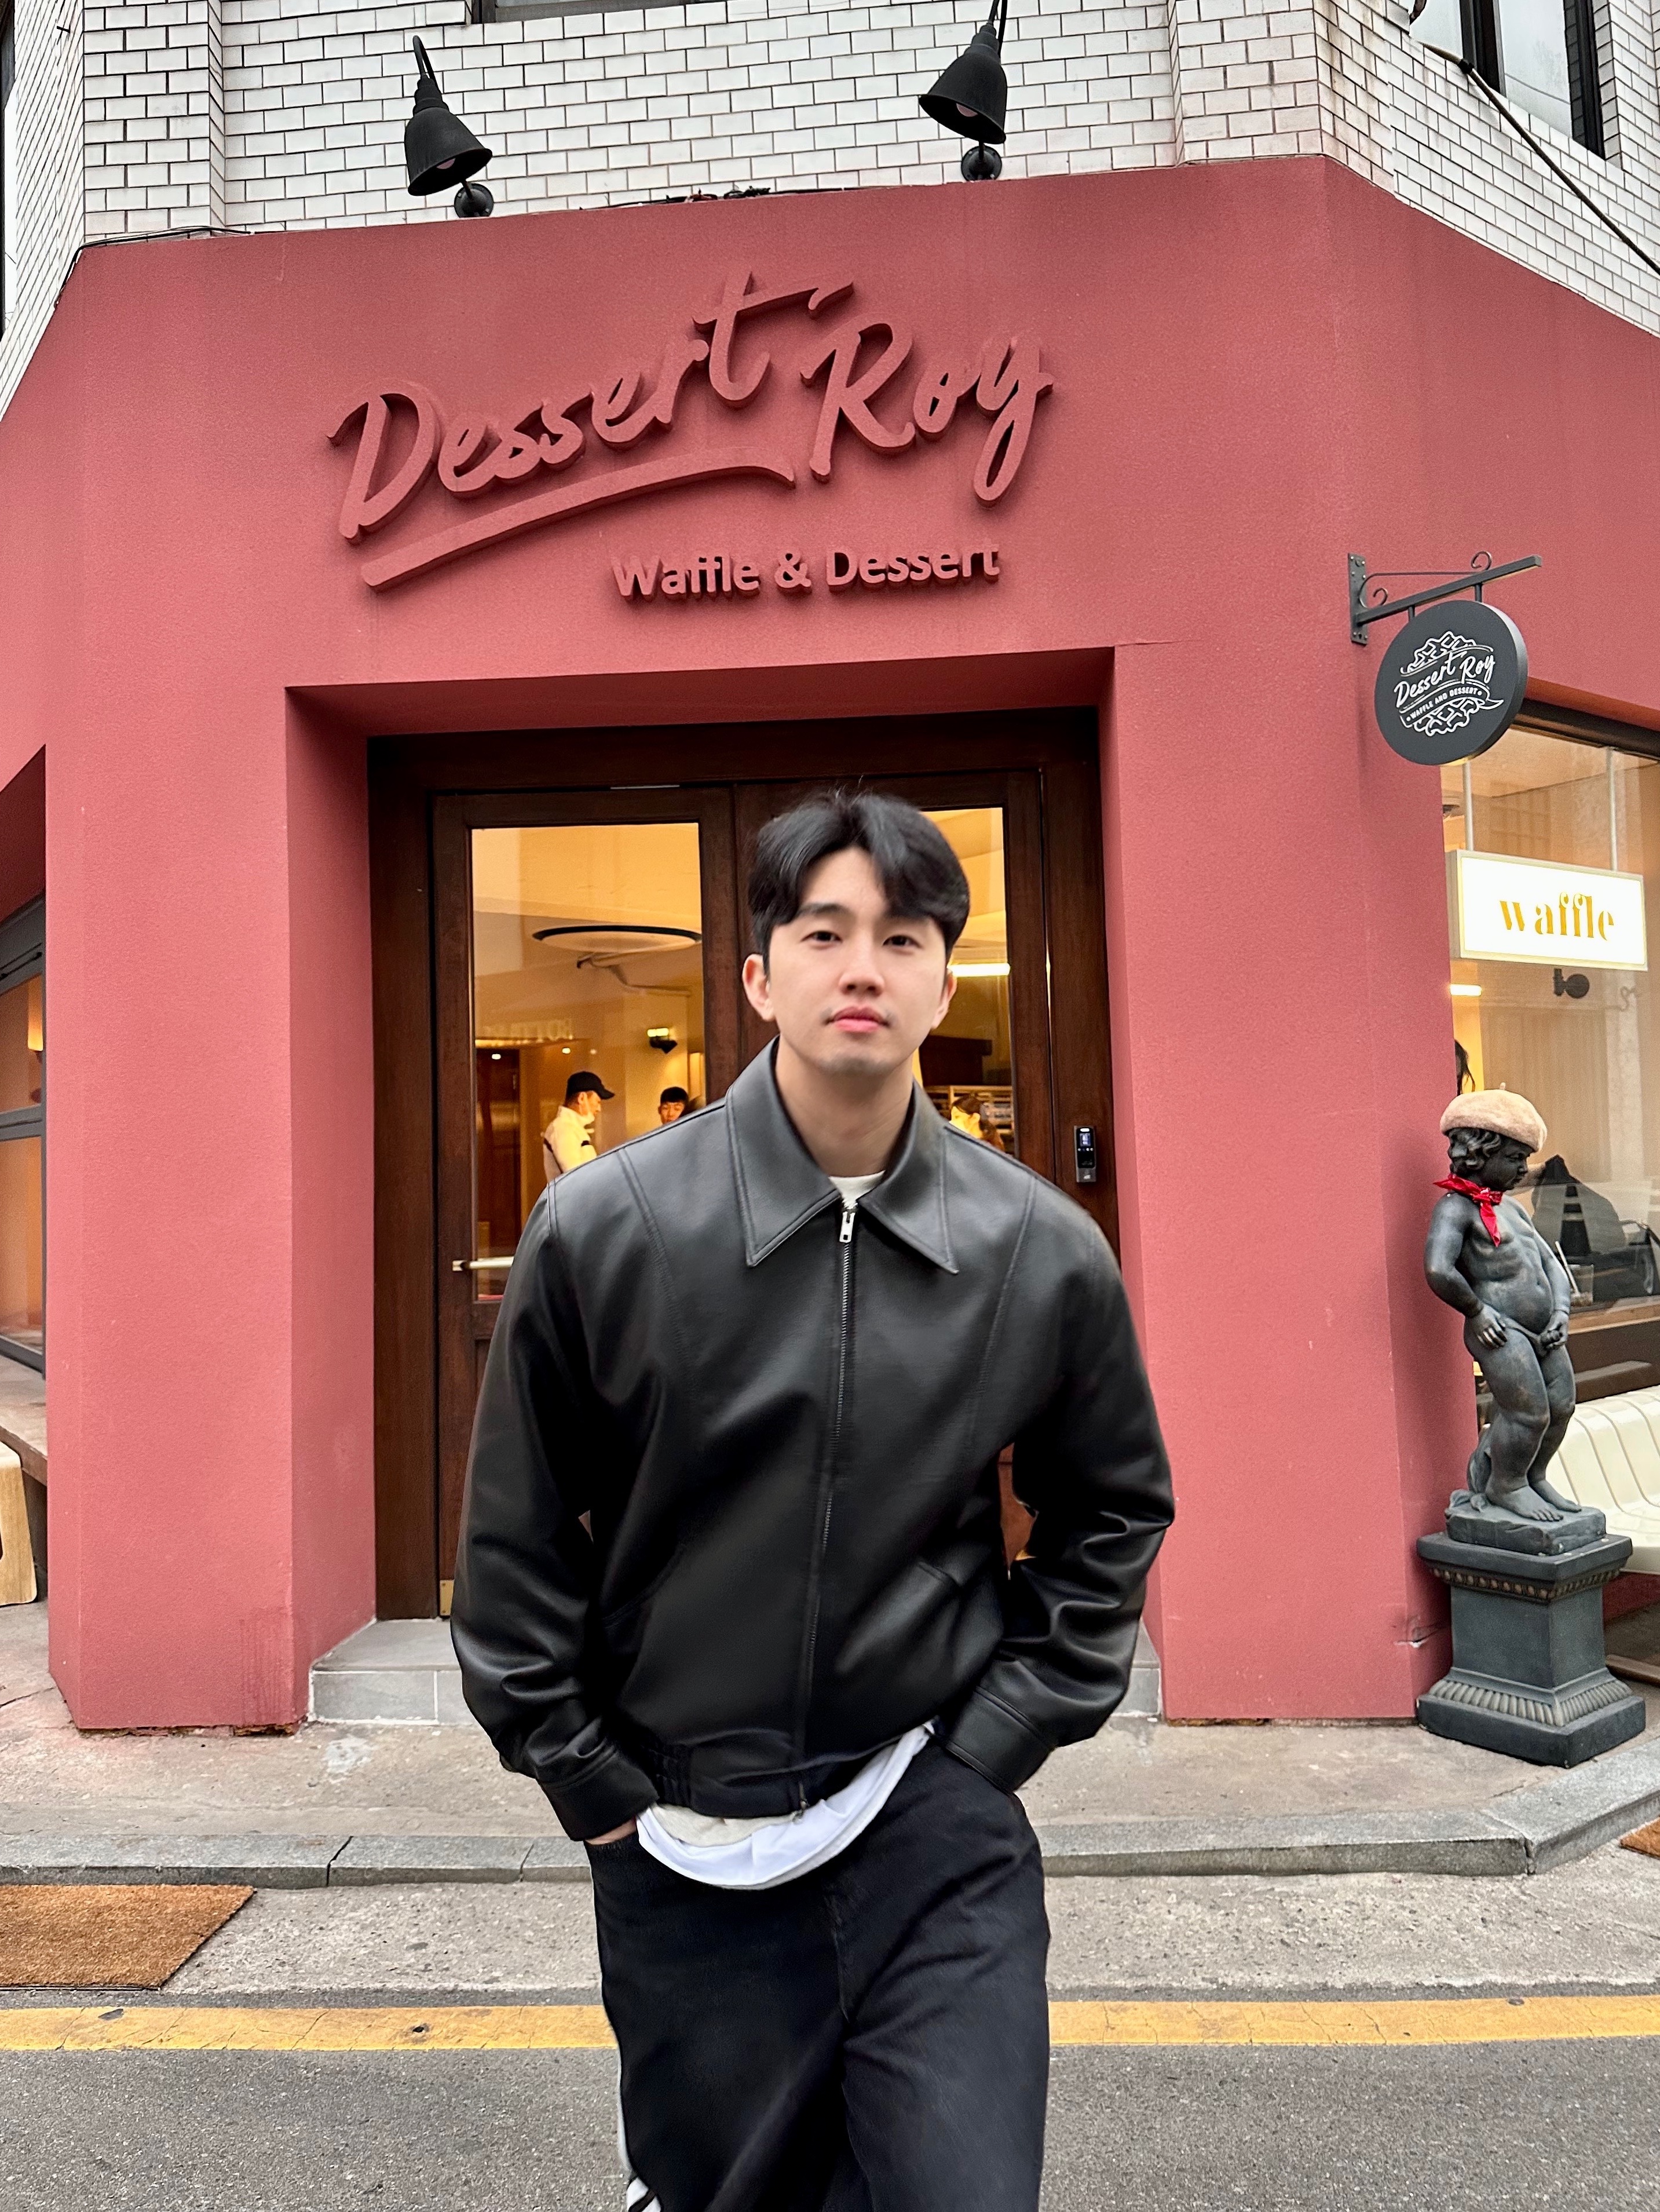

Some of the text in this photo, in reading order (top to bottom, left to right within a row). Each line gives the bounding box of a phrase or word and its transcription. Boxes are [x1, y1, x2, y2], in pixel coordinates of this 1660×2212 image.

[328, 270, 1054, 541] Dessert Roy
[613, 542, 1001, 598] Waffle & Dessert
[1394, 650, 1496, 708] Dessert Roy
[1410, 686, 1478, 719] WAFFLE AND DESSERT
[1498, 891, 1614, 941] waffle
